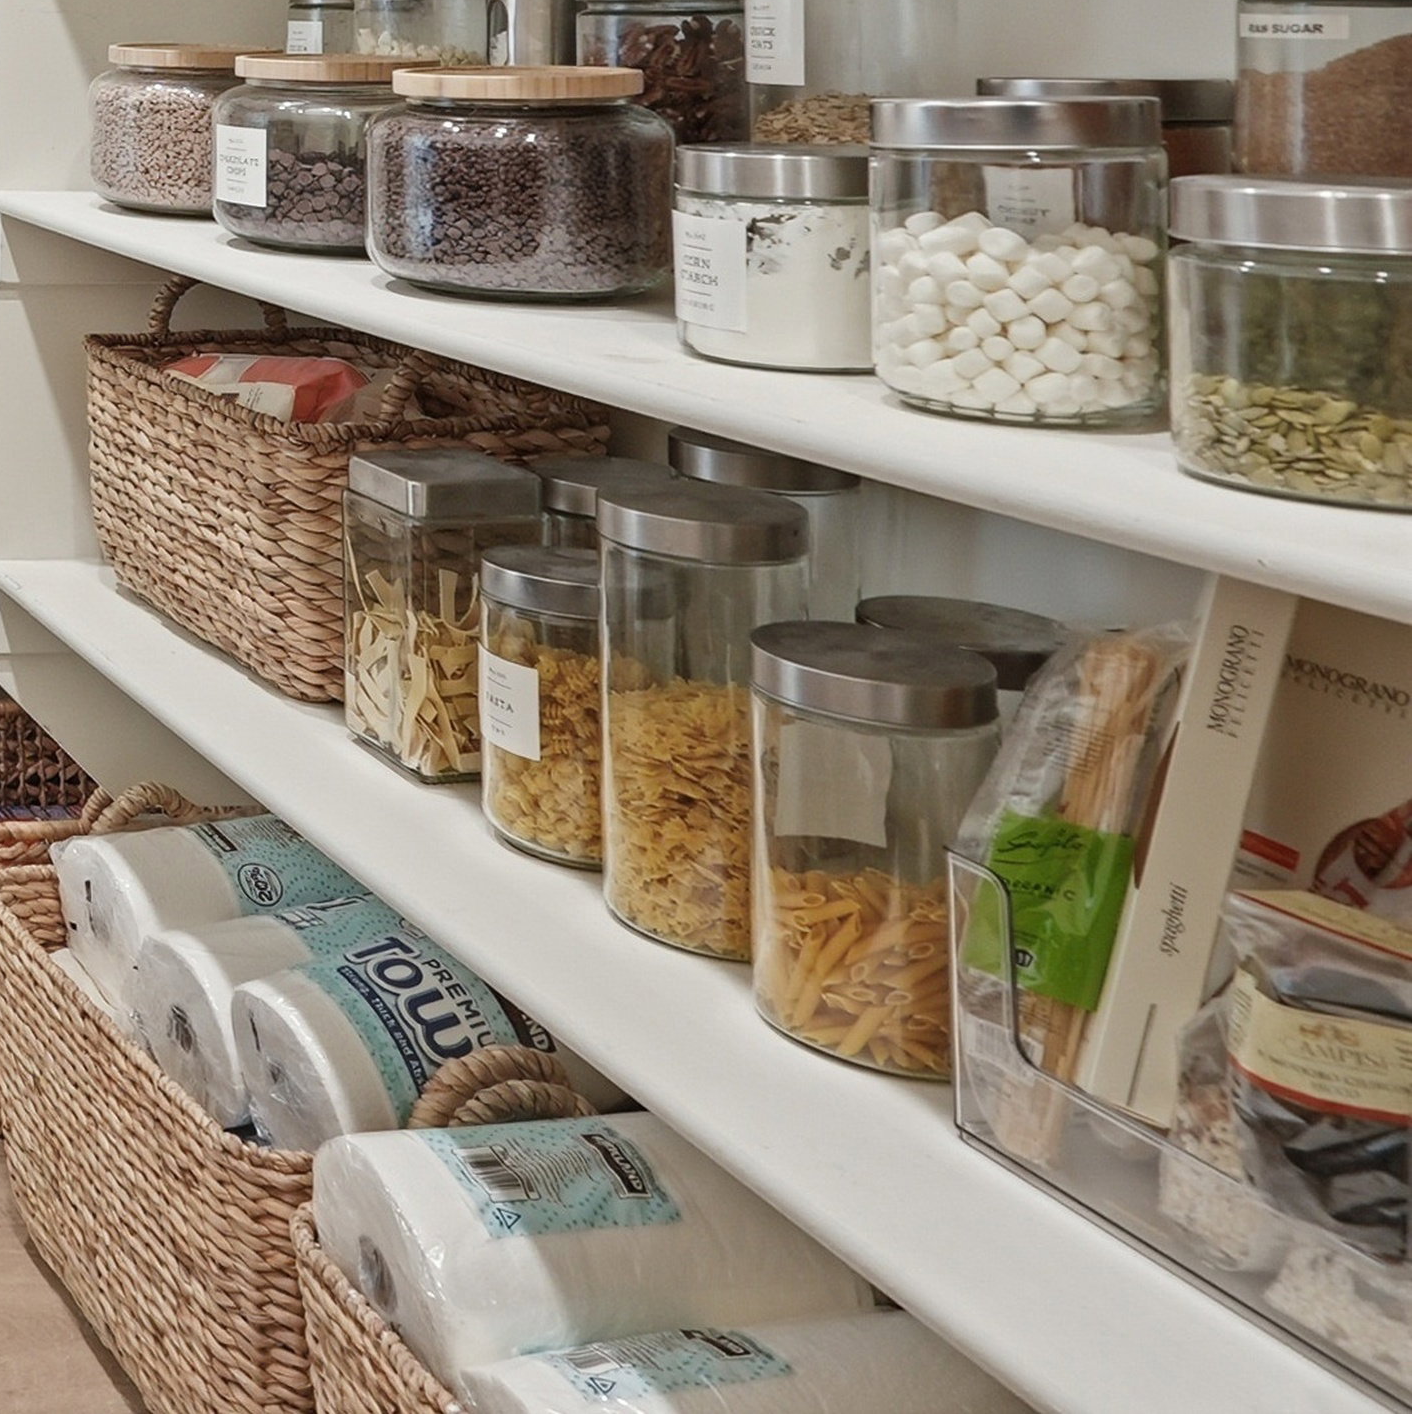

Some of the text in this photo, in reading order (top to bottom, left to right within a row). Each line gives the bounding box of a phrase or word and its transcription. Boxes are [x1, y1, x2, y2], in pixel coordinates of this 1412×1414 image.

[1272, 23, 1323, 34] SUGAR
[1206, 623, 1251, 734] MONOGRANO
[1285, 654, 1410, 708] MONOGRANO
[1160, 881, 1189, 958] spaghetti
[349, 936, 475, 1061] TOW
[371, 997, 397, 1028] Thick
[422, 958, 497, 1049] PREMIU
